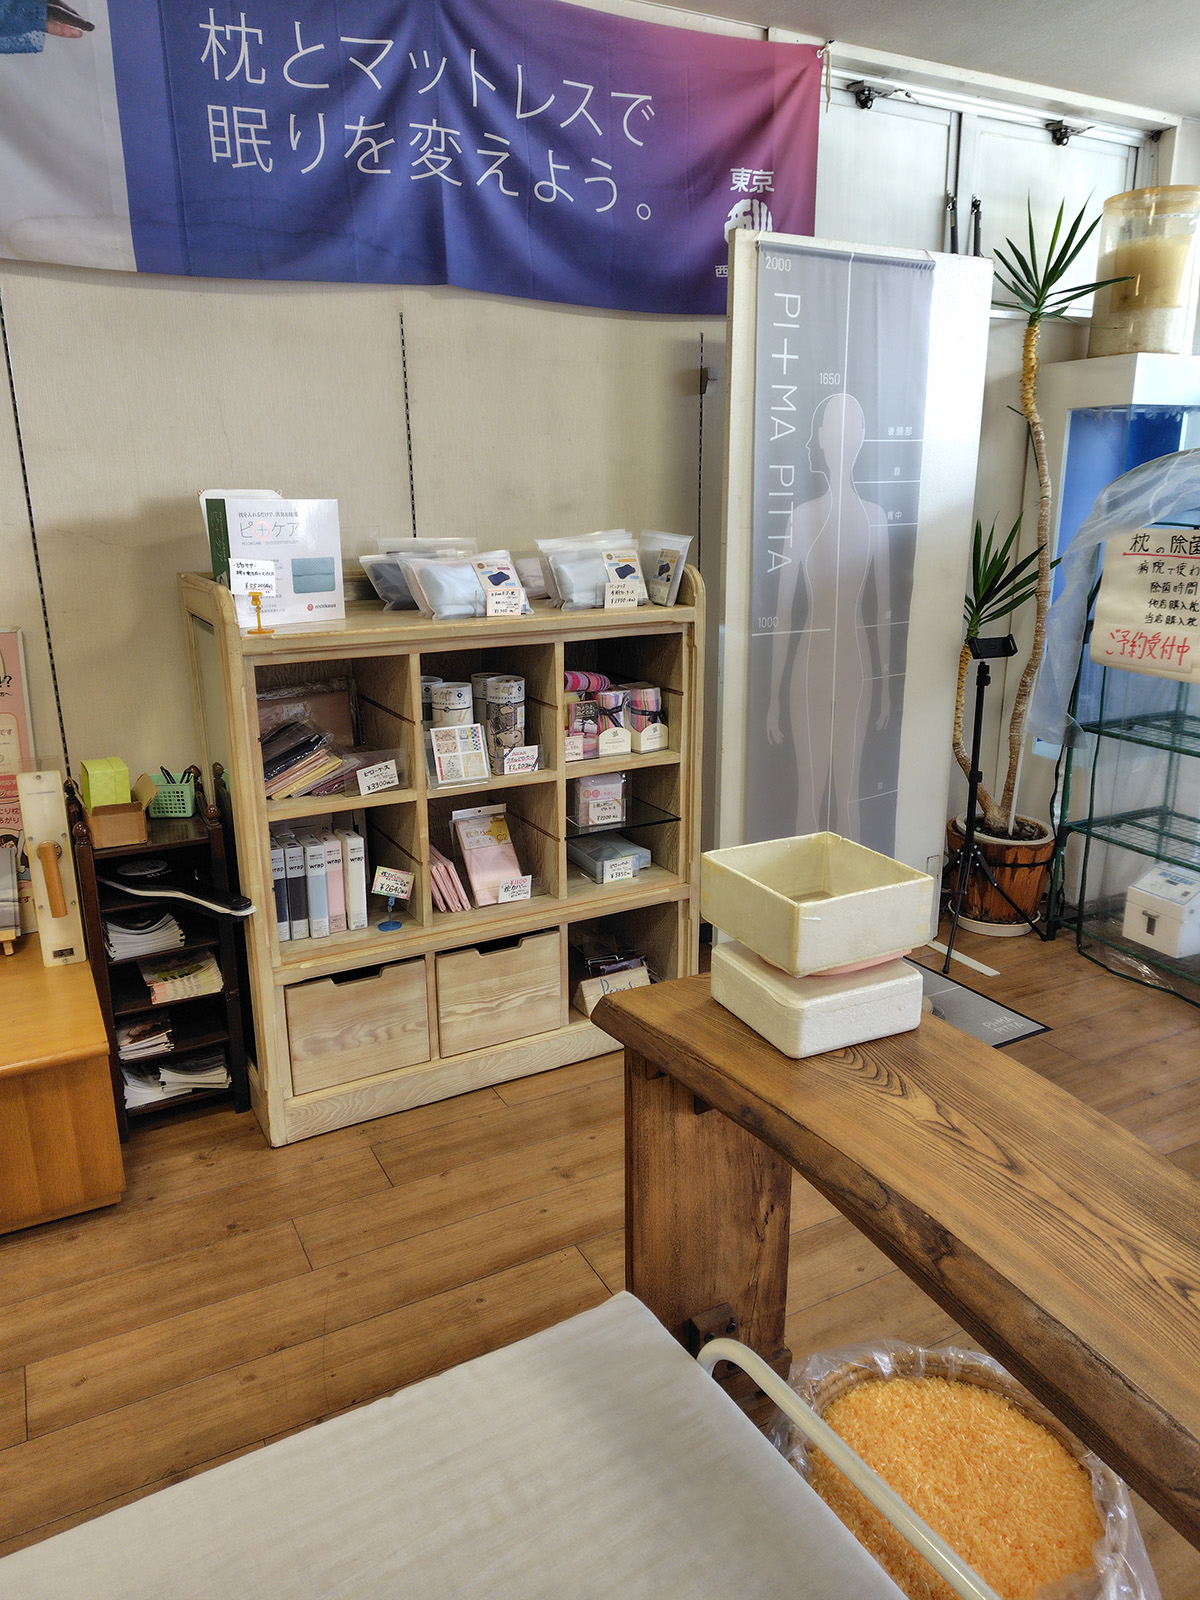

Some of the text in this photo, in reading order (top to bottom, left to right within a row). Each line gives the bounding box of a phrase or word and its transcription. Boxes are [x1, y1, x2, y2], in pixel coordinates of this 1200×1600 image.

[199, 7, 655, 147] 枕とマットレスで
[207, 103, 653, 221] 眠りを変えよう。
[730, 167, 775, 193] 東京
[765, 256, 792, 272] 2000
[819, 372, 841, 385] 1650
[887, 426, 913, 437] 後頭部
[767, 465, 795, 574] PITTA
[887, 511, 903, 521] 背中
[1129, 532, 1200, 556] 枕の除菌
[1149, 581, 1199, 596] 除菌時間
[757, 616, 779, 629] 1000
[1144, 611, 1199, 627] 当店購入枕
[1104, 629, 1191, 667] ご予約受付中
[288, 864, 304, 872] wrap
